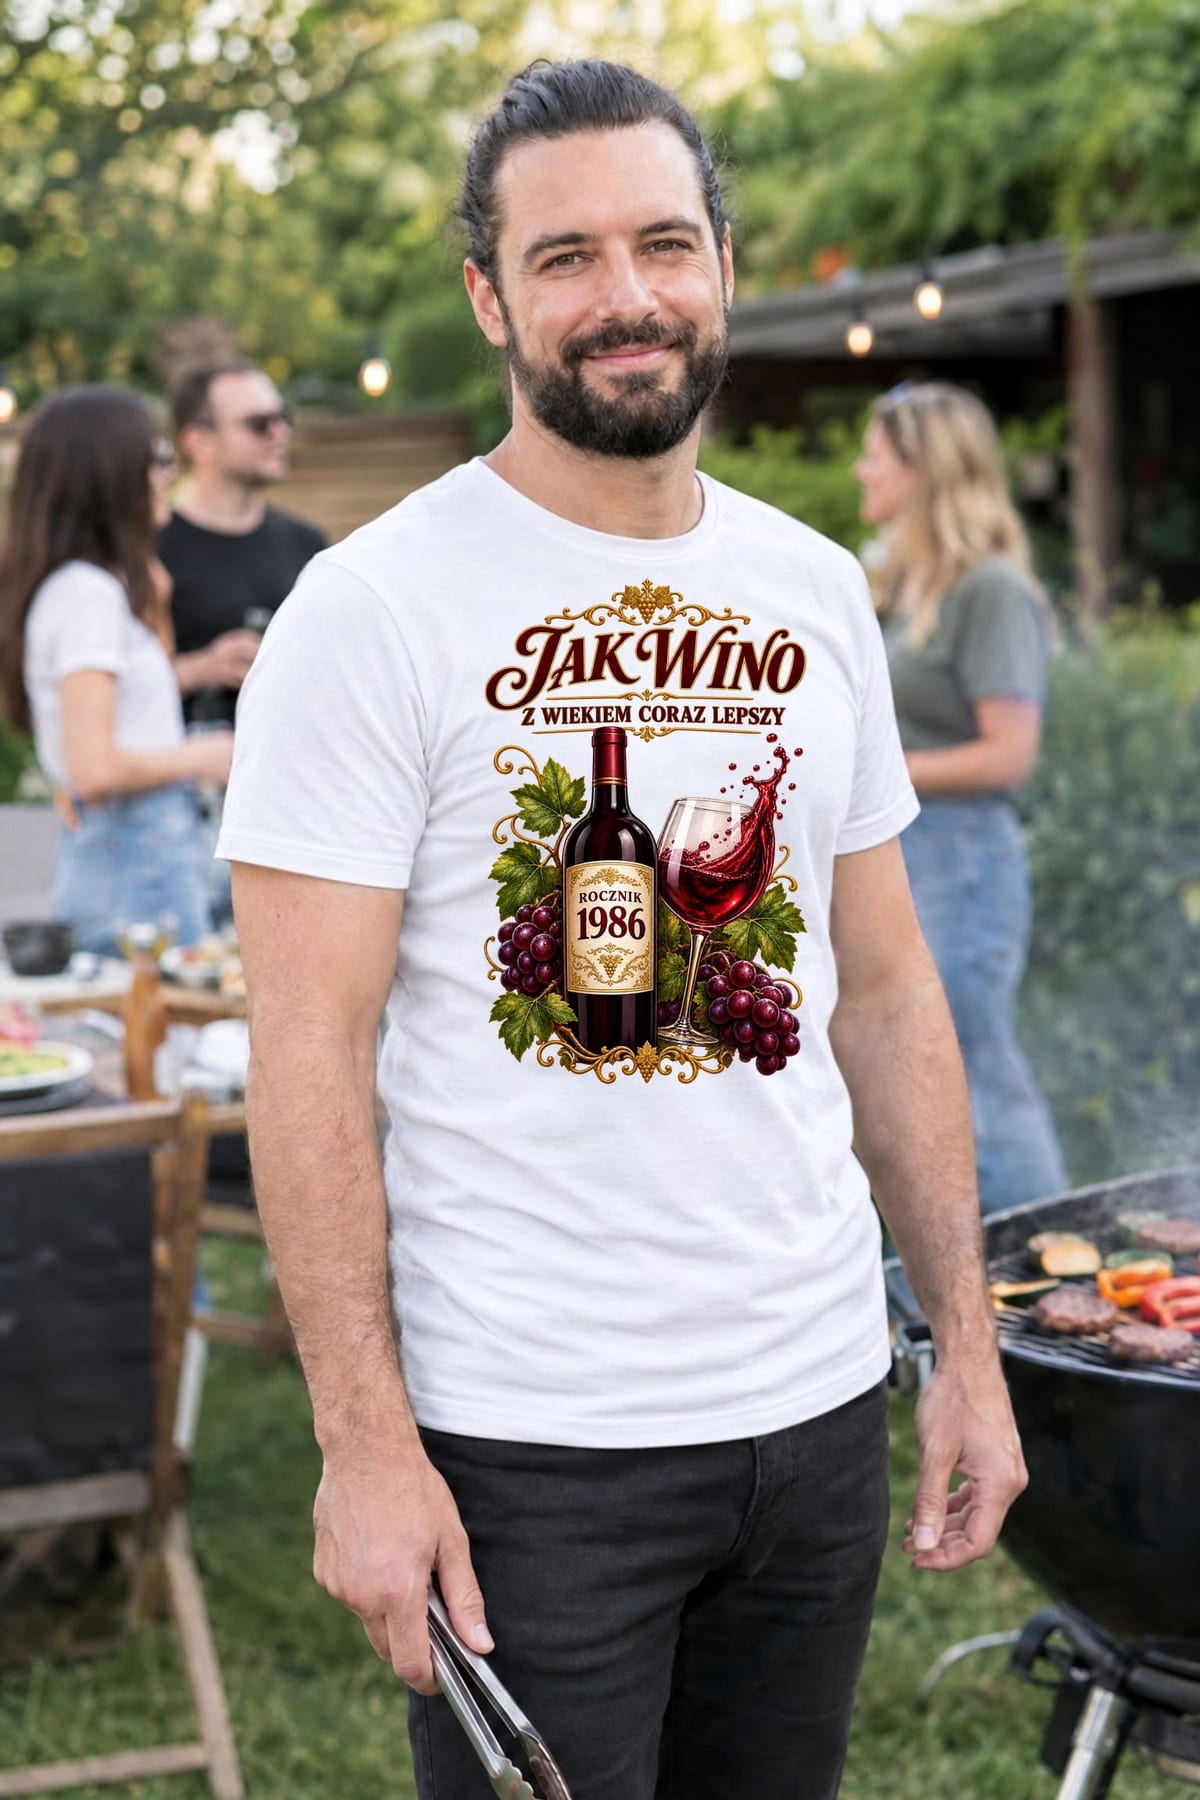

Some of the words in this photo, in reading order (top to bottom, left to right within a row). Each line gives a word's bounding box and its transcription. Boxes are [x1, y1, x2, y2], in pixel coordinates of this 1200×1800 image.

[484, 623, 641, 711] JAK
[636, 624, 807, 694] WINO
[520, 707, 535, 726] Z
[542, 706, 632, 725] WIEKIEM
[638, 705, 706, 724] CORAZ
[712, 706, 787, 726] LEPSZY
[579, 890, 643, 904] ROCZNIK
[576, 905, 646, 941] 1986
